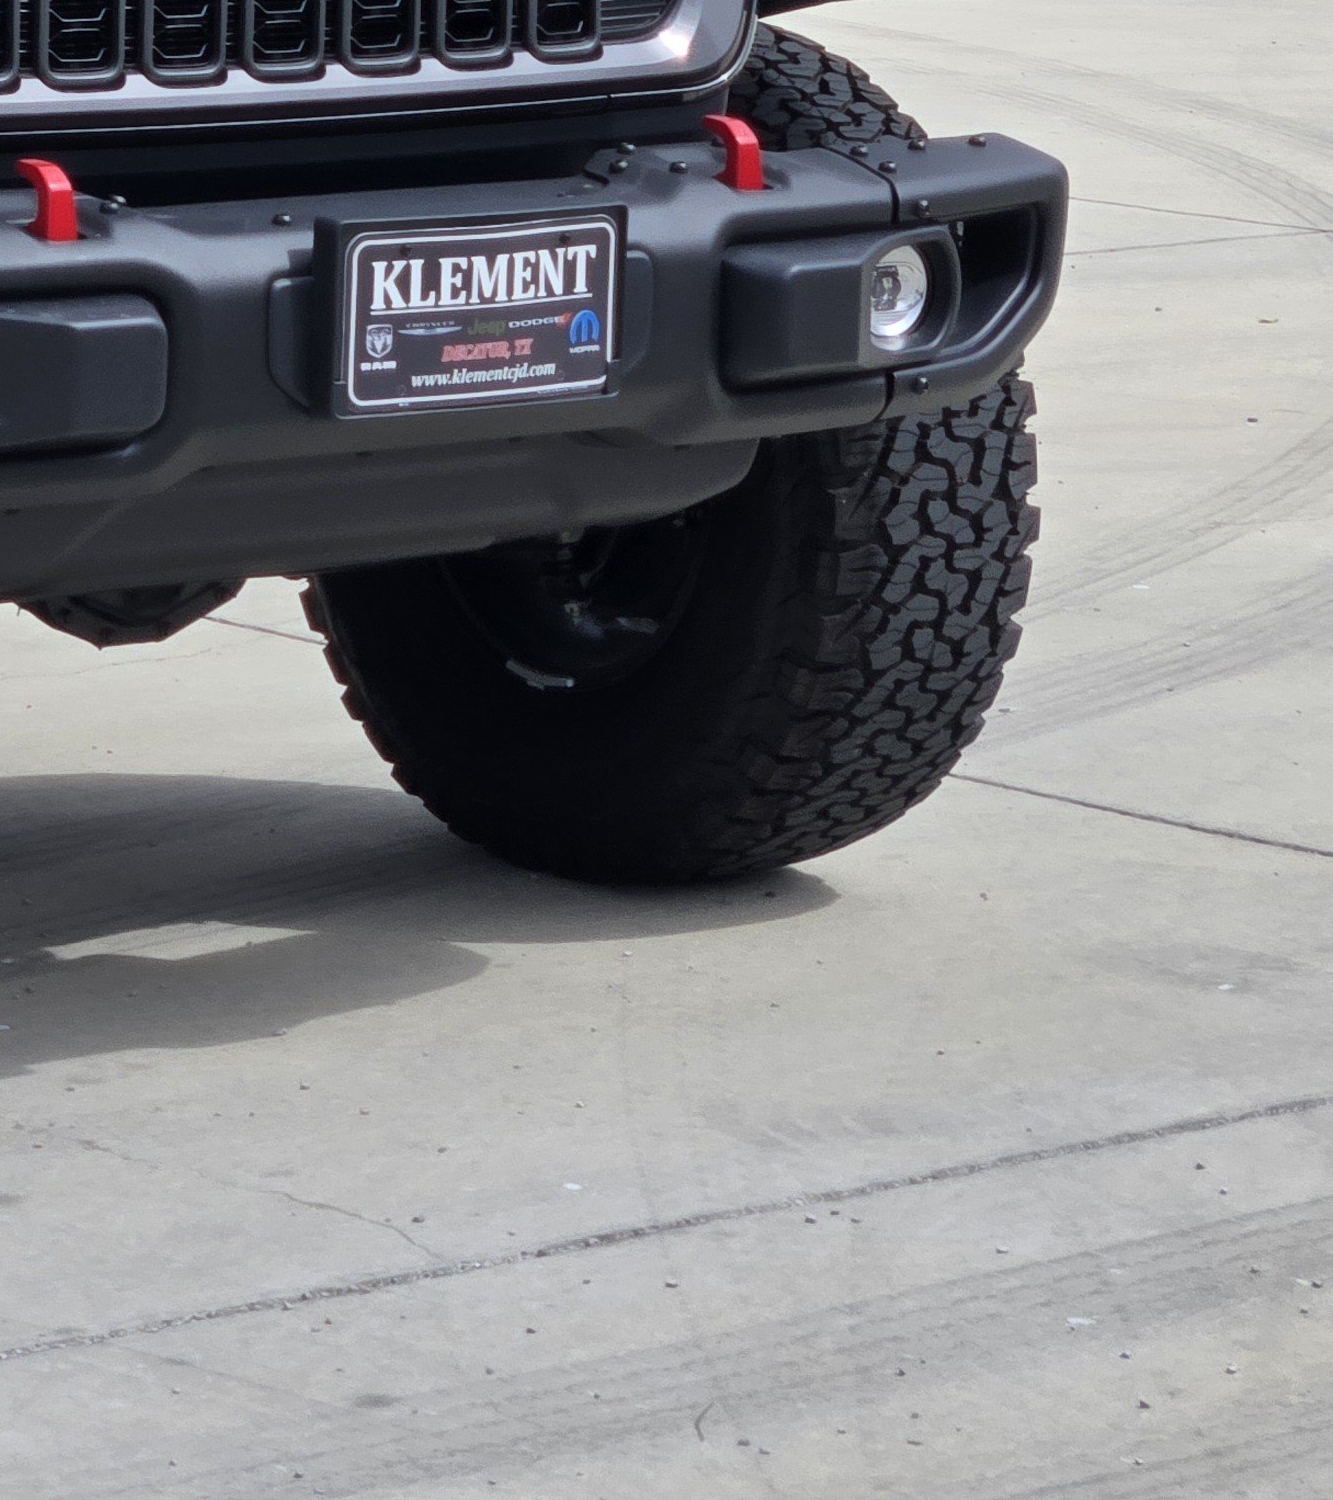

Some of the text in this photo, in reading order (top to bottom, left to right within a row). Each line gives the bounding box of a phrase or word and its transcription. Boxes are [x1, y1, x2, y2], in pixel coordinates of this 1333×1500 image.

[369, 244, 597, 311] KLEMENT
[467, 318, 507, 337] Jeep
[411, 361, 557, 389] www.klementcjd.com
